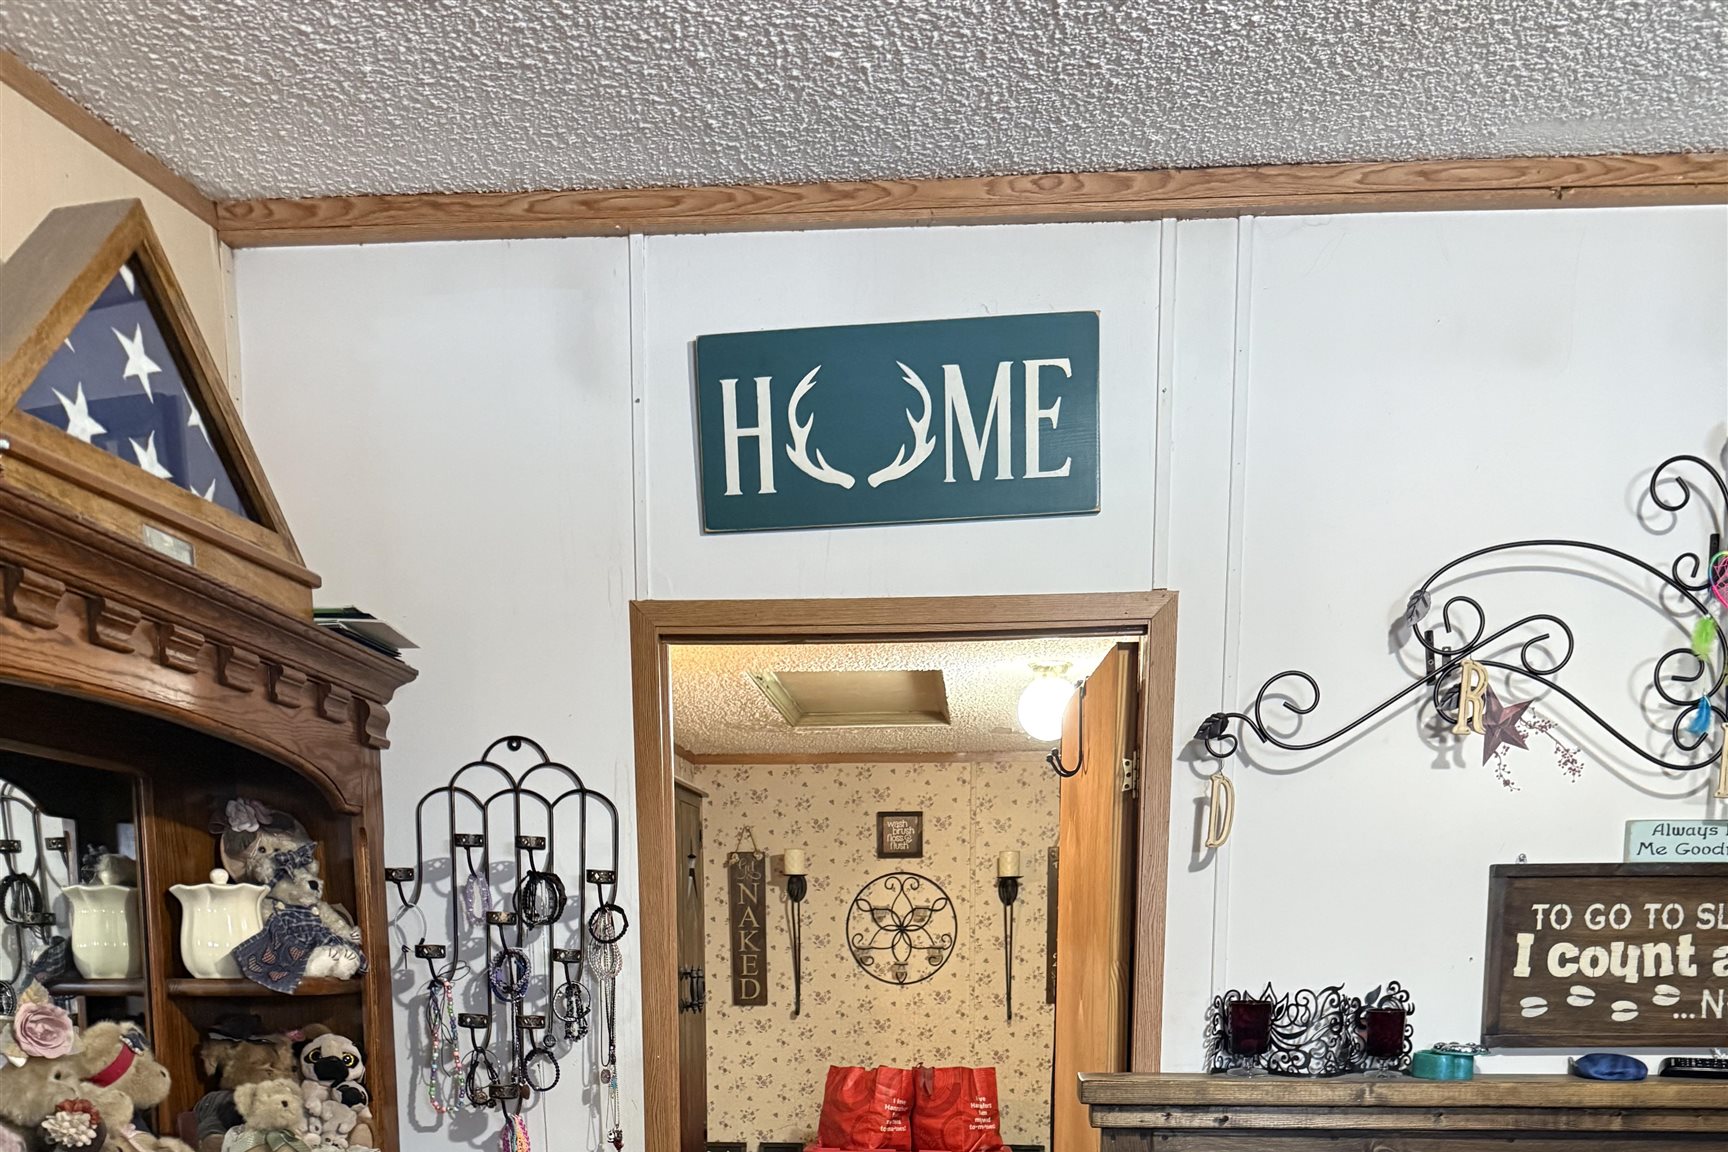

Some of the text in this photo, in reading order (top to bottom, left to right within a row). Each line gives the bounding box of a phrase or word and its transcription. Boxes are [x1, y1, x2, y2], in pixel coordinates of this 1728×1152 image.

[887, 819, 908, 828] wash
[892, 826, 915, 836] brush
[1651, 822, 1719, 841] Always
[886, 834, 904, 842] floss
[890, 841, 910, 850] flush
[1636, 841, 1728, 856] Me Good
[1531, 903, 1573, 931] TO
[1584, 903, 1632, 930] GO
[1643, 903, 1685, 930] TO
[736, 882, 762, 1000] NAKED
[1513, 932, 1535, 978] I
[1547, 933, 1698, 984] count
[1673, 988, 1728, 1019] ...N
